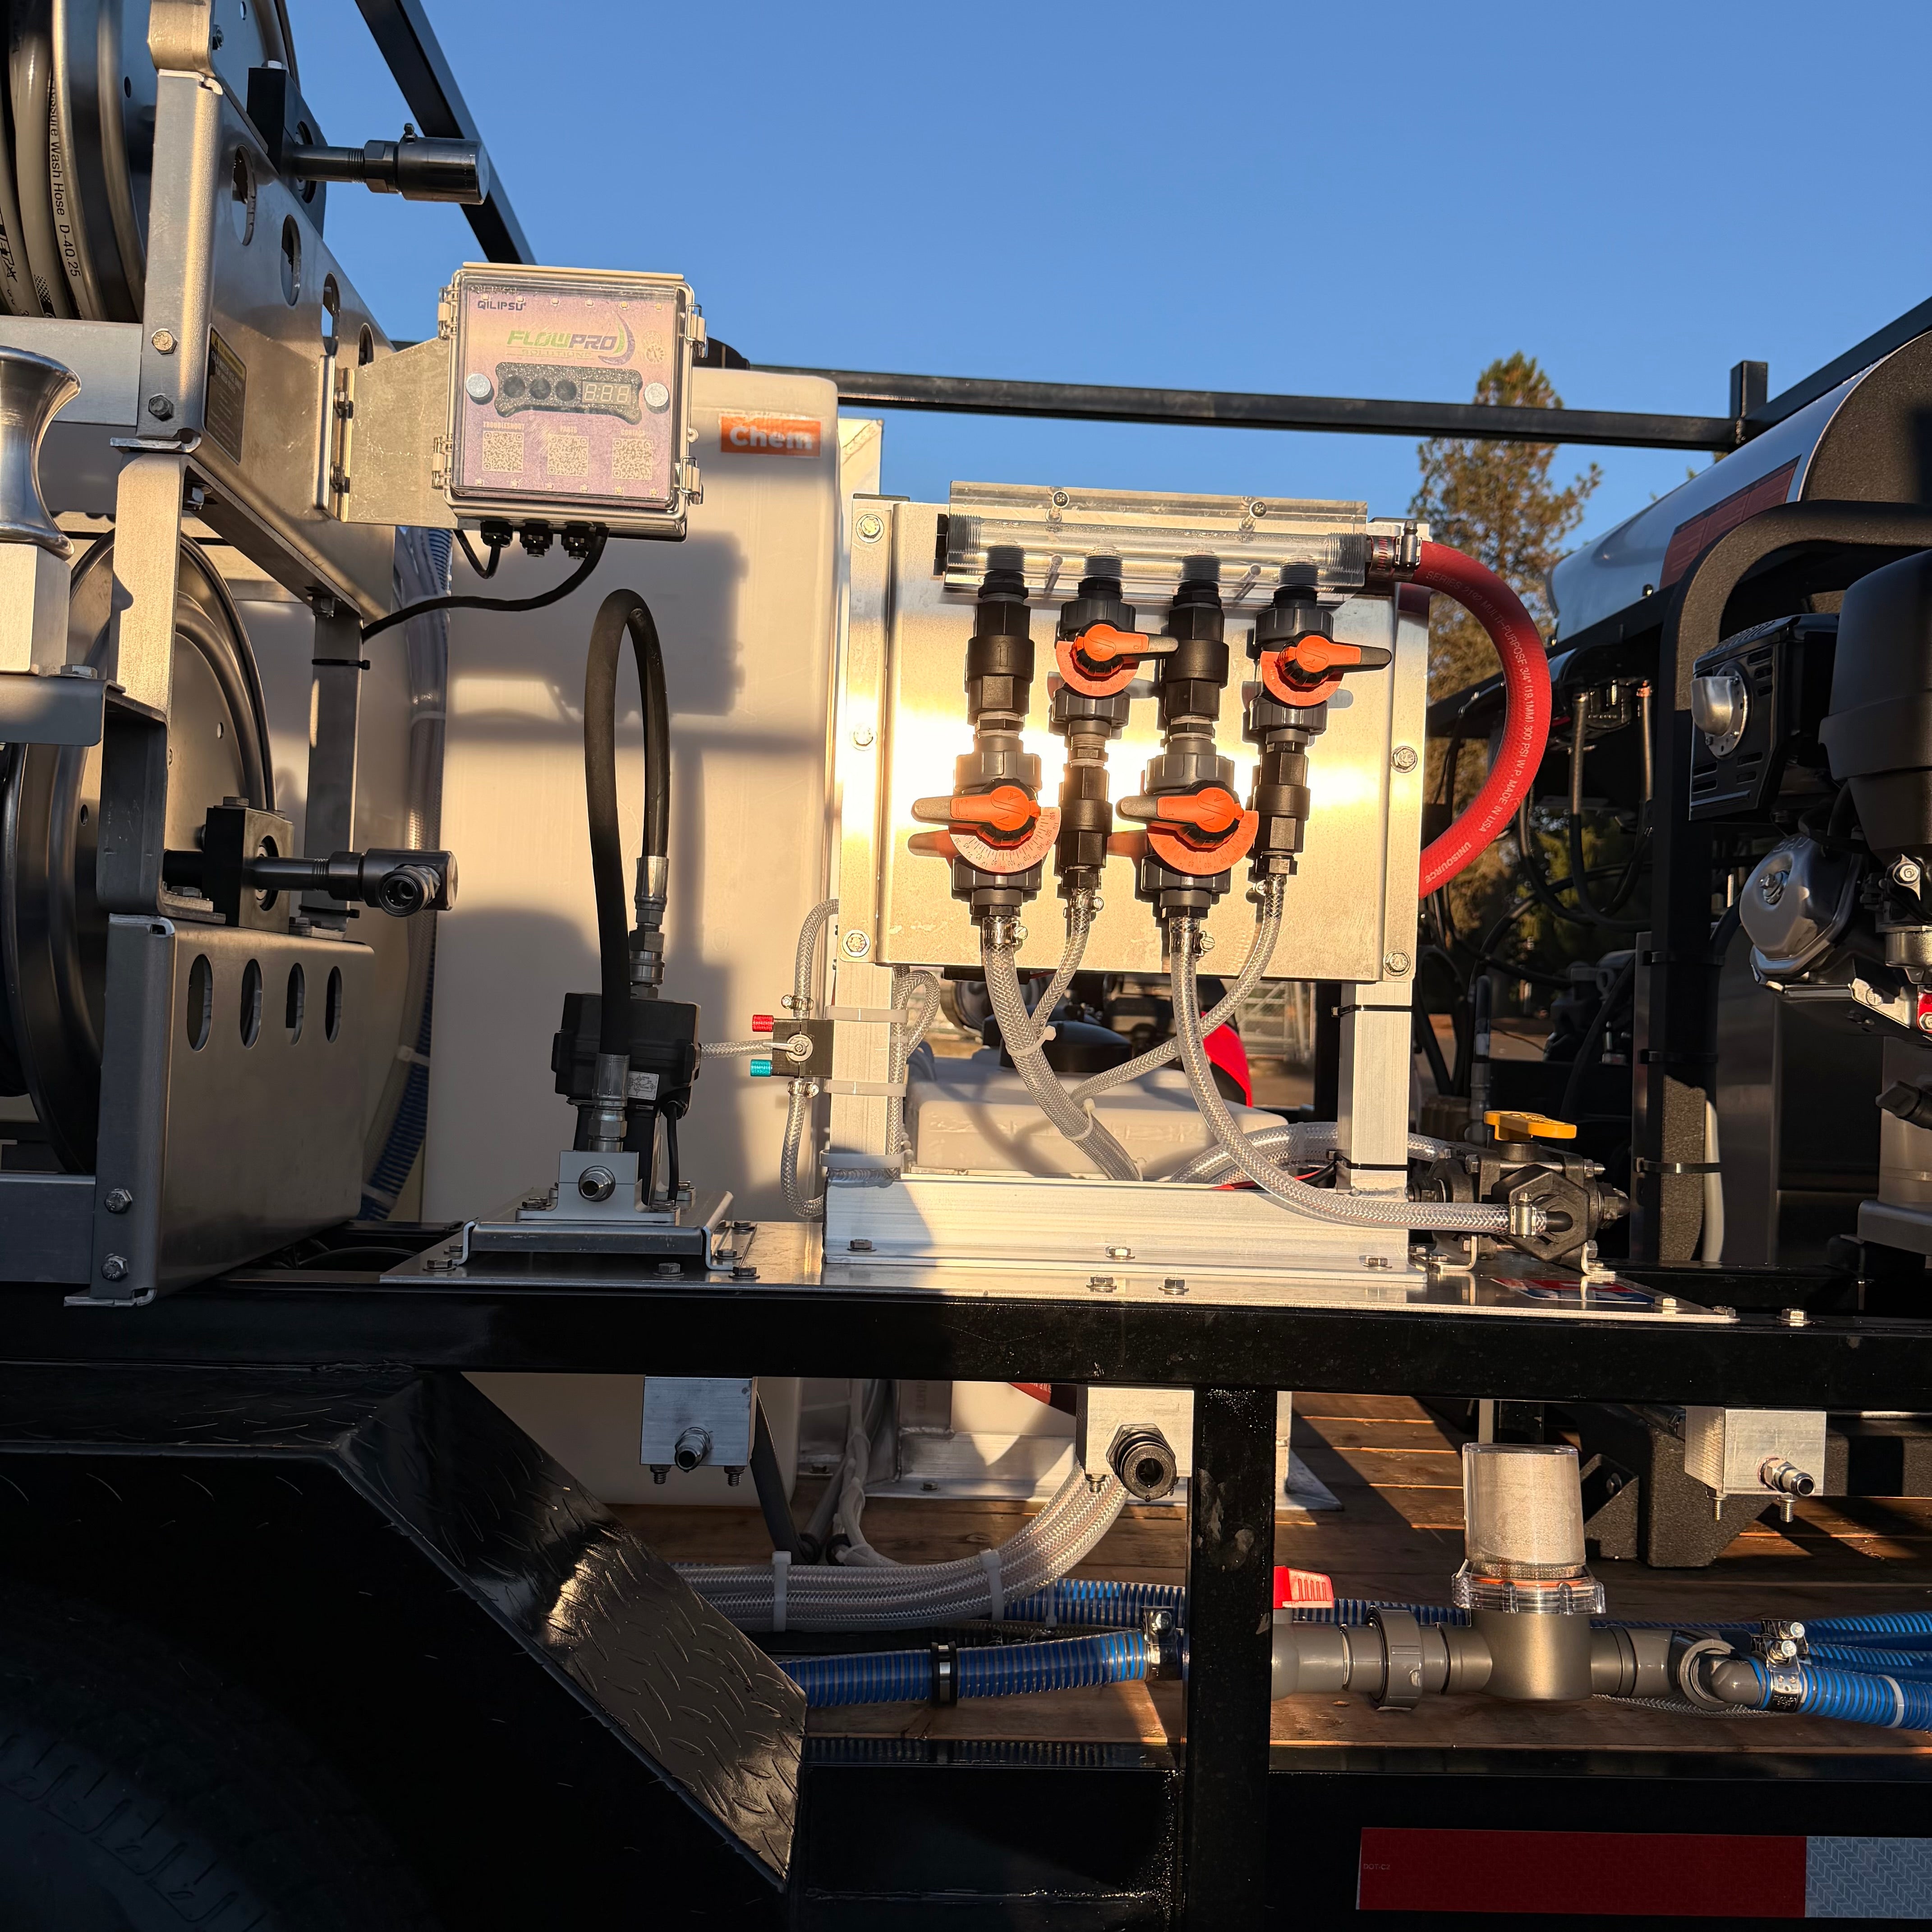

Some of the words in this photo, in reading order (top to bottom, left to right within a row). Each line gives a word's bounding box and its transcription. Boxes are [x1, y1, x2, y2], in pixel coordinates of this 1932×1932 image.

[53, 184, 65, 216] Hose
[483, 421, 524, 430] TROUBLESHOOT
[560, 425, 578, 433] PARTS
[729, 426, 812, 450] Chem
[1426, 571, 1462, 589] SERIES
[1462, 587, 1483, 601] 2192
[1523, 725, 1533, 740] 300
[1519, 743, 1530, 757] PSI
[1499, 779, 1518, 805] MADE
[1491, 805, 1503, 815] IN
[1478, 815, 1495, 832] USA
[1424, 842, 1472, 884] UNISOURCE
